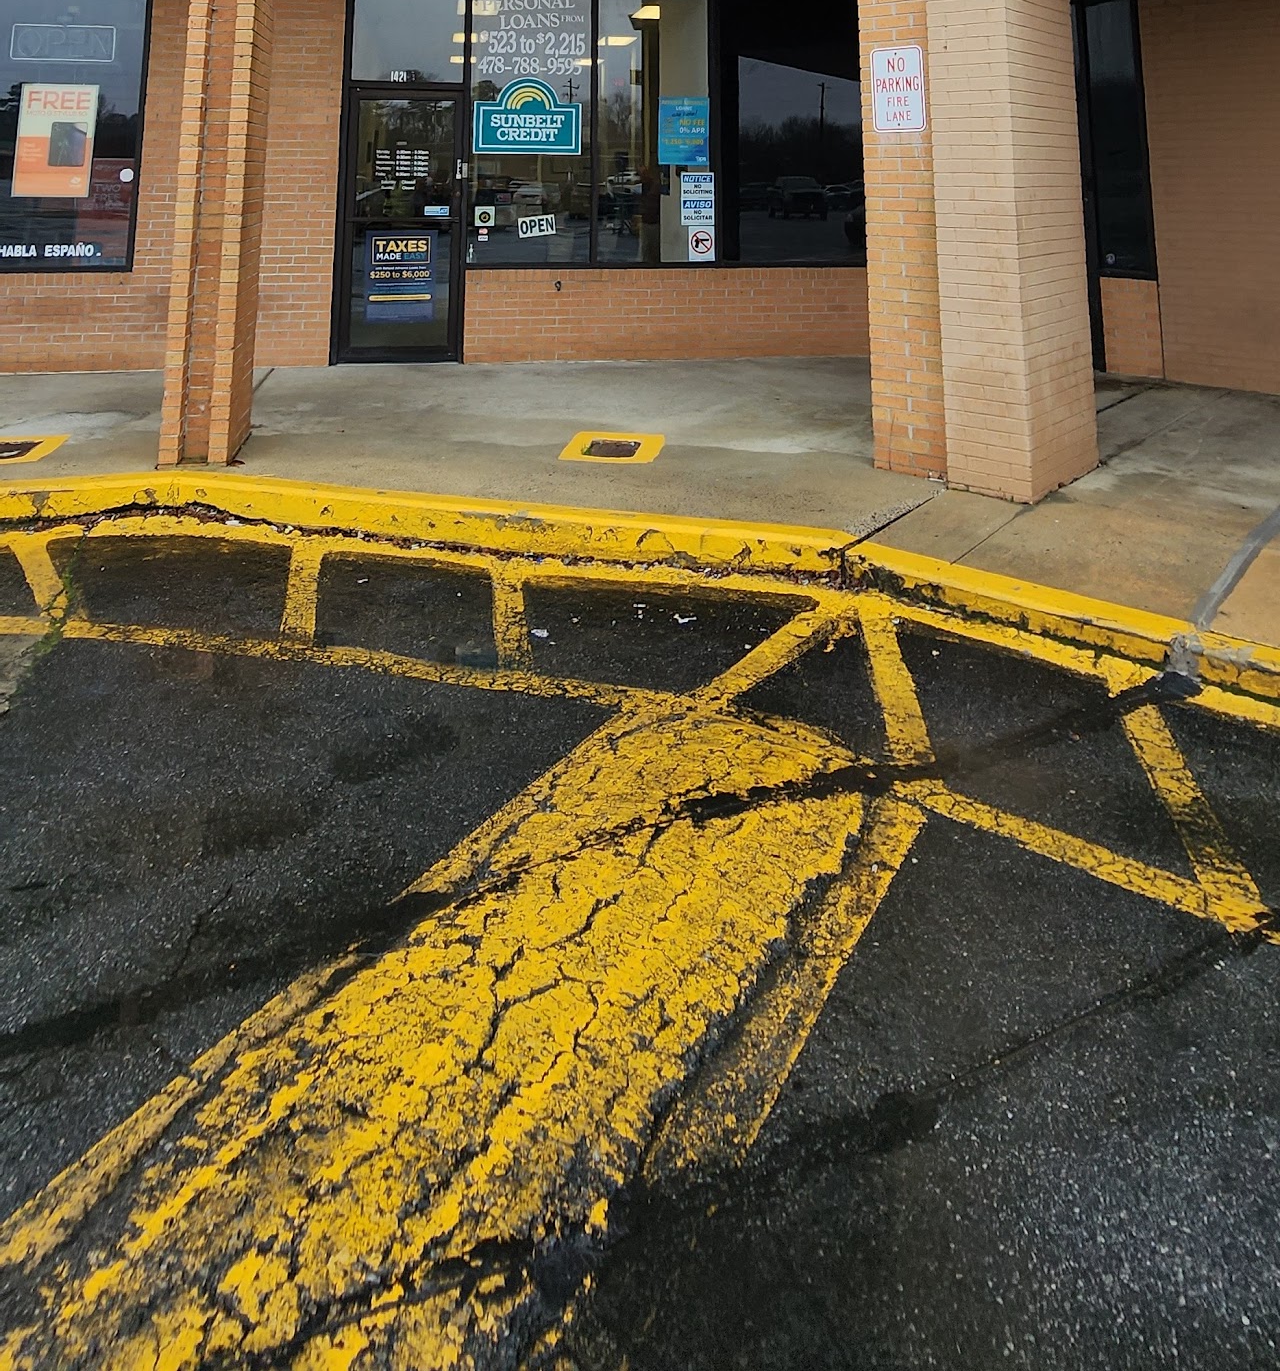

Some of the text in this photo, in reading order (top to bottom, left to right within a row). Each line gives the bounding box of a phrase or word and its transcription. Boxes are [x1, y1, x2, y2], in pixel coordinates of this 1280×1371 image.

[500, 13, 584, 30] LOANS FROM
[480, 30, 586, 58] $523 to $2,215
[887, 57, 905, 73] NO
[876, 76, 920, 93] PARKING
[27, 91, 91, 110] FREE
[887, 96, 909, 107] FIRE
[490, 114, 565, 128] SUNBELT
[886, 111, 912, 122] LANE
[496, 128, 558, 141] CREDIT
[520, 217, 554, 234] OPEN
[376, 240, 427, 252] TAXES
[404, 252, 427, 260] EASY
[370, 271, 391, 279] $250
